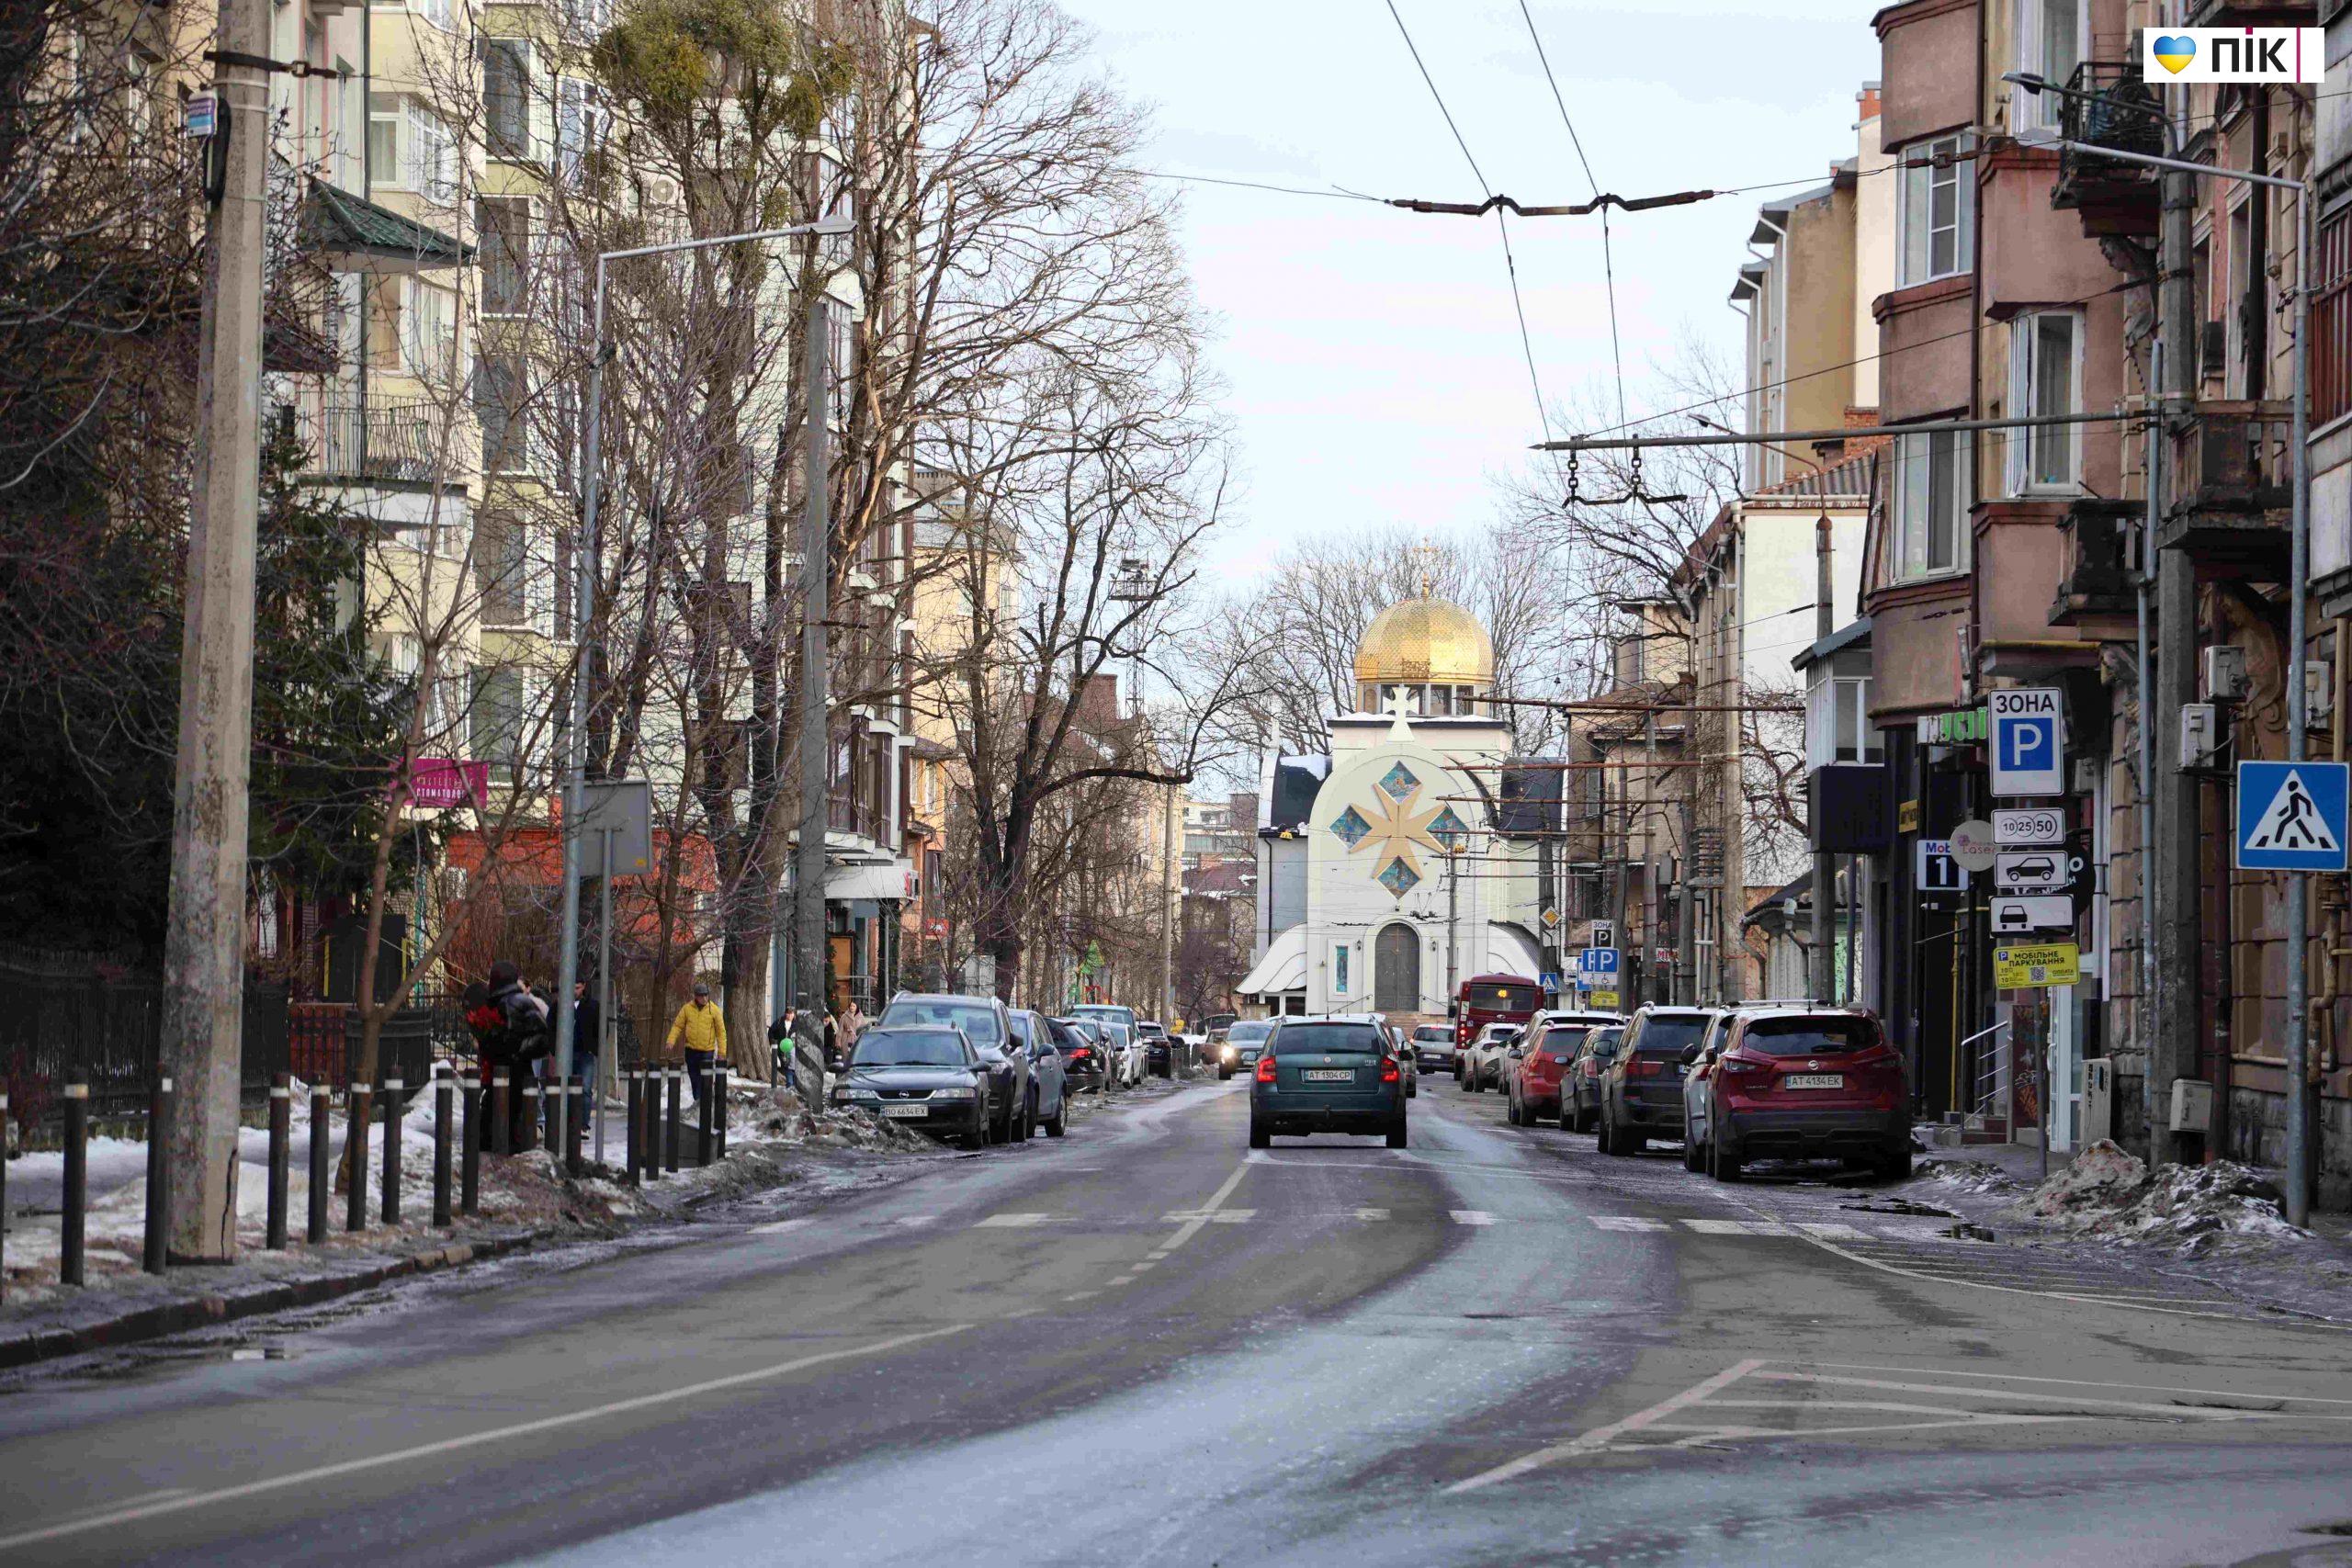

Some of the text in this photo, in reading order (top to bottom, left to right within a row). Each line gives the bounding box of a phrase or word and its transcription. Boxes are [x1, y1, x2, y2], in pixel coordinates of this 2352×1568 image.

[1996, 694, 2055, 714] ЗОНА
[2013, 724, 2042, 766] P
[2003, 820, 2052, 832] 10 25 50
[2014, 950, 2059, 960] МОБІЛЬНЕ
[1600, 952, 1613, 970] P
[2008, 957, 2064, 967] ПАРКУВАННЯ
[1309, 1071, 1321, 1079] AT
[1792, 1076, 1840, 1086] AT 4134 EK
